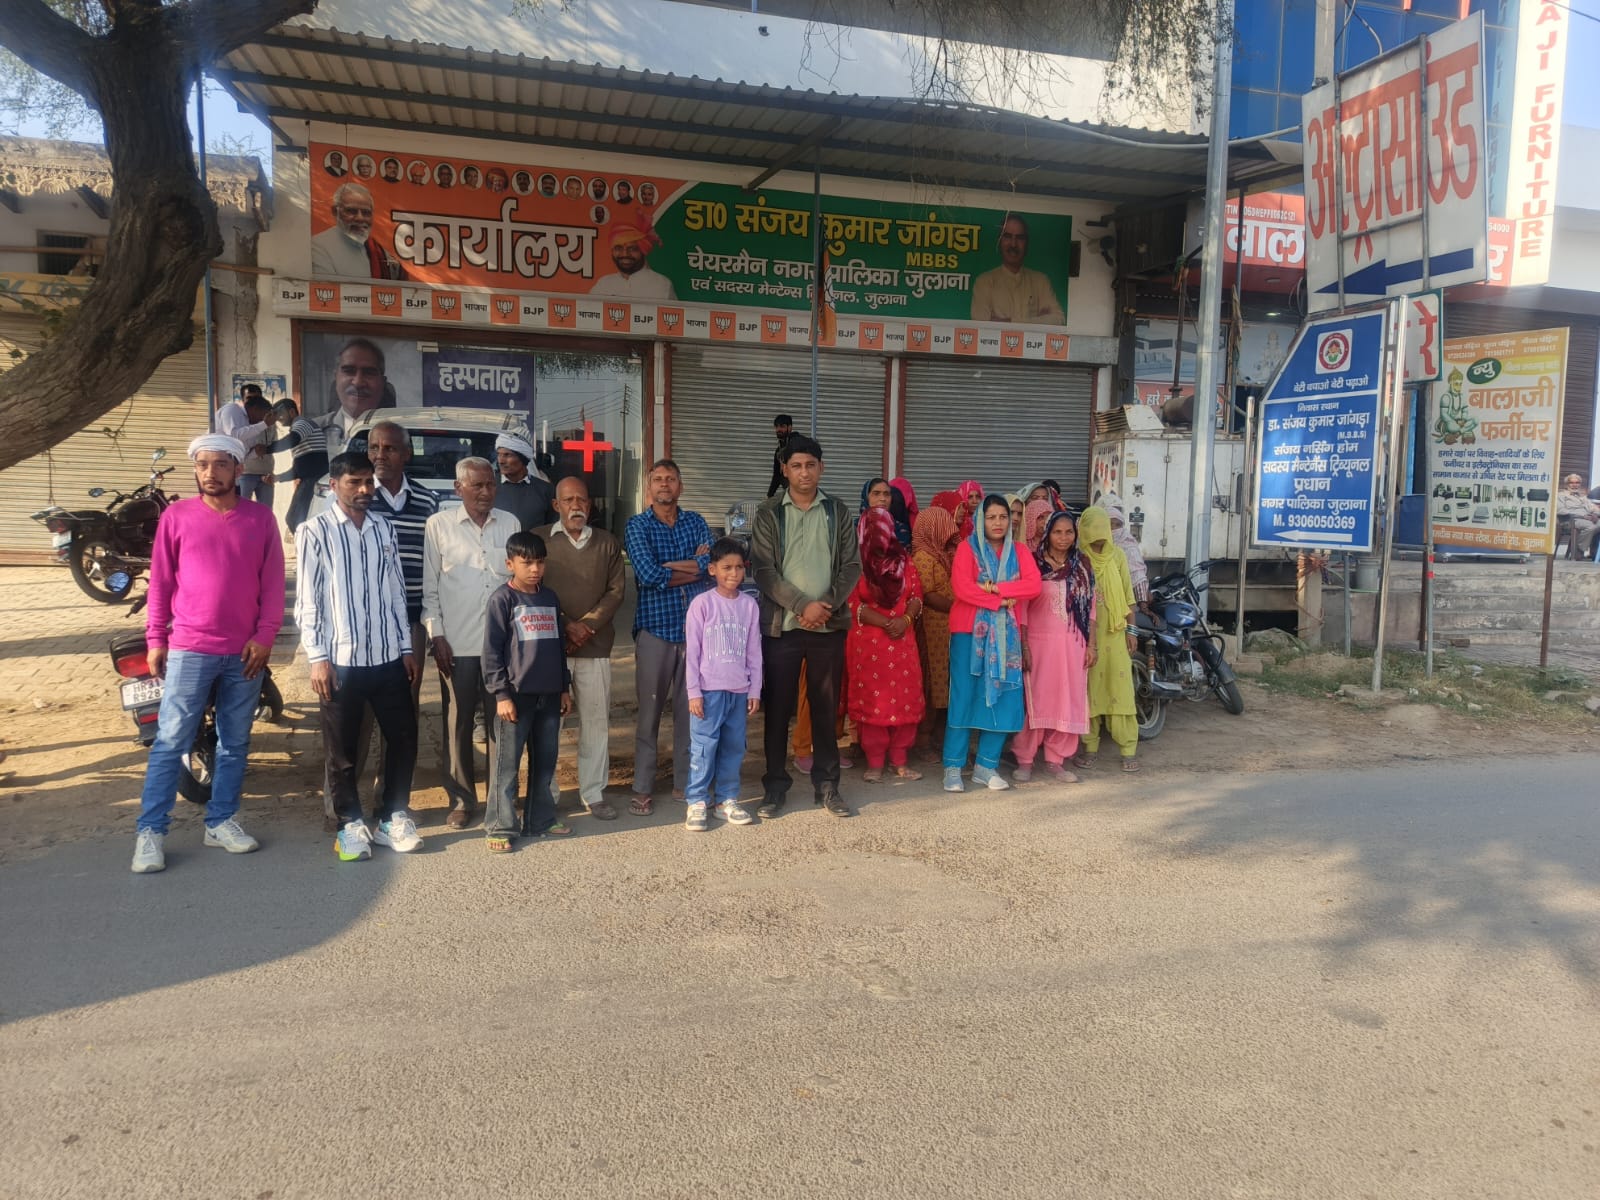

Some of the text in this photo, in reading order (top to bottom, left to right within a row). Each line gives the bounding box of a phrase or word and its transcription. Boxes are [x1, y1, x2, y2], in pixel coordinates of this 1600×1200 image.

[1520, 0, 1562, 258] AJI FURNITURE
[392, 197, 599, 278] कार्यालय
[735, 195, 811, 238] संजय
[822, 213, 892, 256] कुमार
[895, 212, 981, 252] जांगडा
[687, 245, 768, 276] चेयरमैन
[904, 270, 971, 298] जुलाना
[906, 252, 958, 269] MBBS
[691, 276, 713, 291] एवं
[714, 281, 754, 294] सदस्य
[864, 292, 908, 309] जुलाना
[282, 290, 1043, 350] BJP भाजपा BJP भाजपा BJP भाजपा BJP भाजपा BJP भाजपा BJP भाजपा BJP भाजपा BJP
[438, 362, 522, 394] हस्पताल
[1293, 381, 1306, 392] बेटी
[1331, 377, 1344, 389] बेटी
[1469, 376, 1556, 410] बालाजी
[1297, 401, 1340, 412] निवास स्थान
[1268, 409, 1371, 432] डा. संजय कुमार जांगड़ा
[1480, 411, 1552, 441] फर्नीचर
[1274, 443, 1301, 456] संजय
[1337, 440, 1359, 454] होम
[1263, 461, 1290, 474] सदस्य
[1330, 454, 1372, 478] ट्रिब्यूनल
[1294, 477, 1332, 494] प्रधान
[1261, 494, 1368, 516] नगर पालिका जुलाना
[1273, 514, 1356, 530] M. 9306050369
[133, 679, 160, 693] HR31
